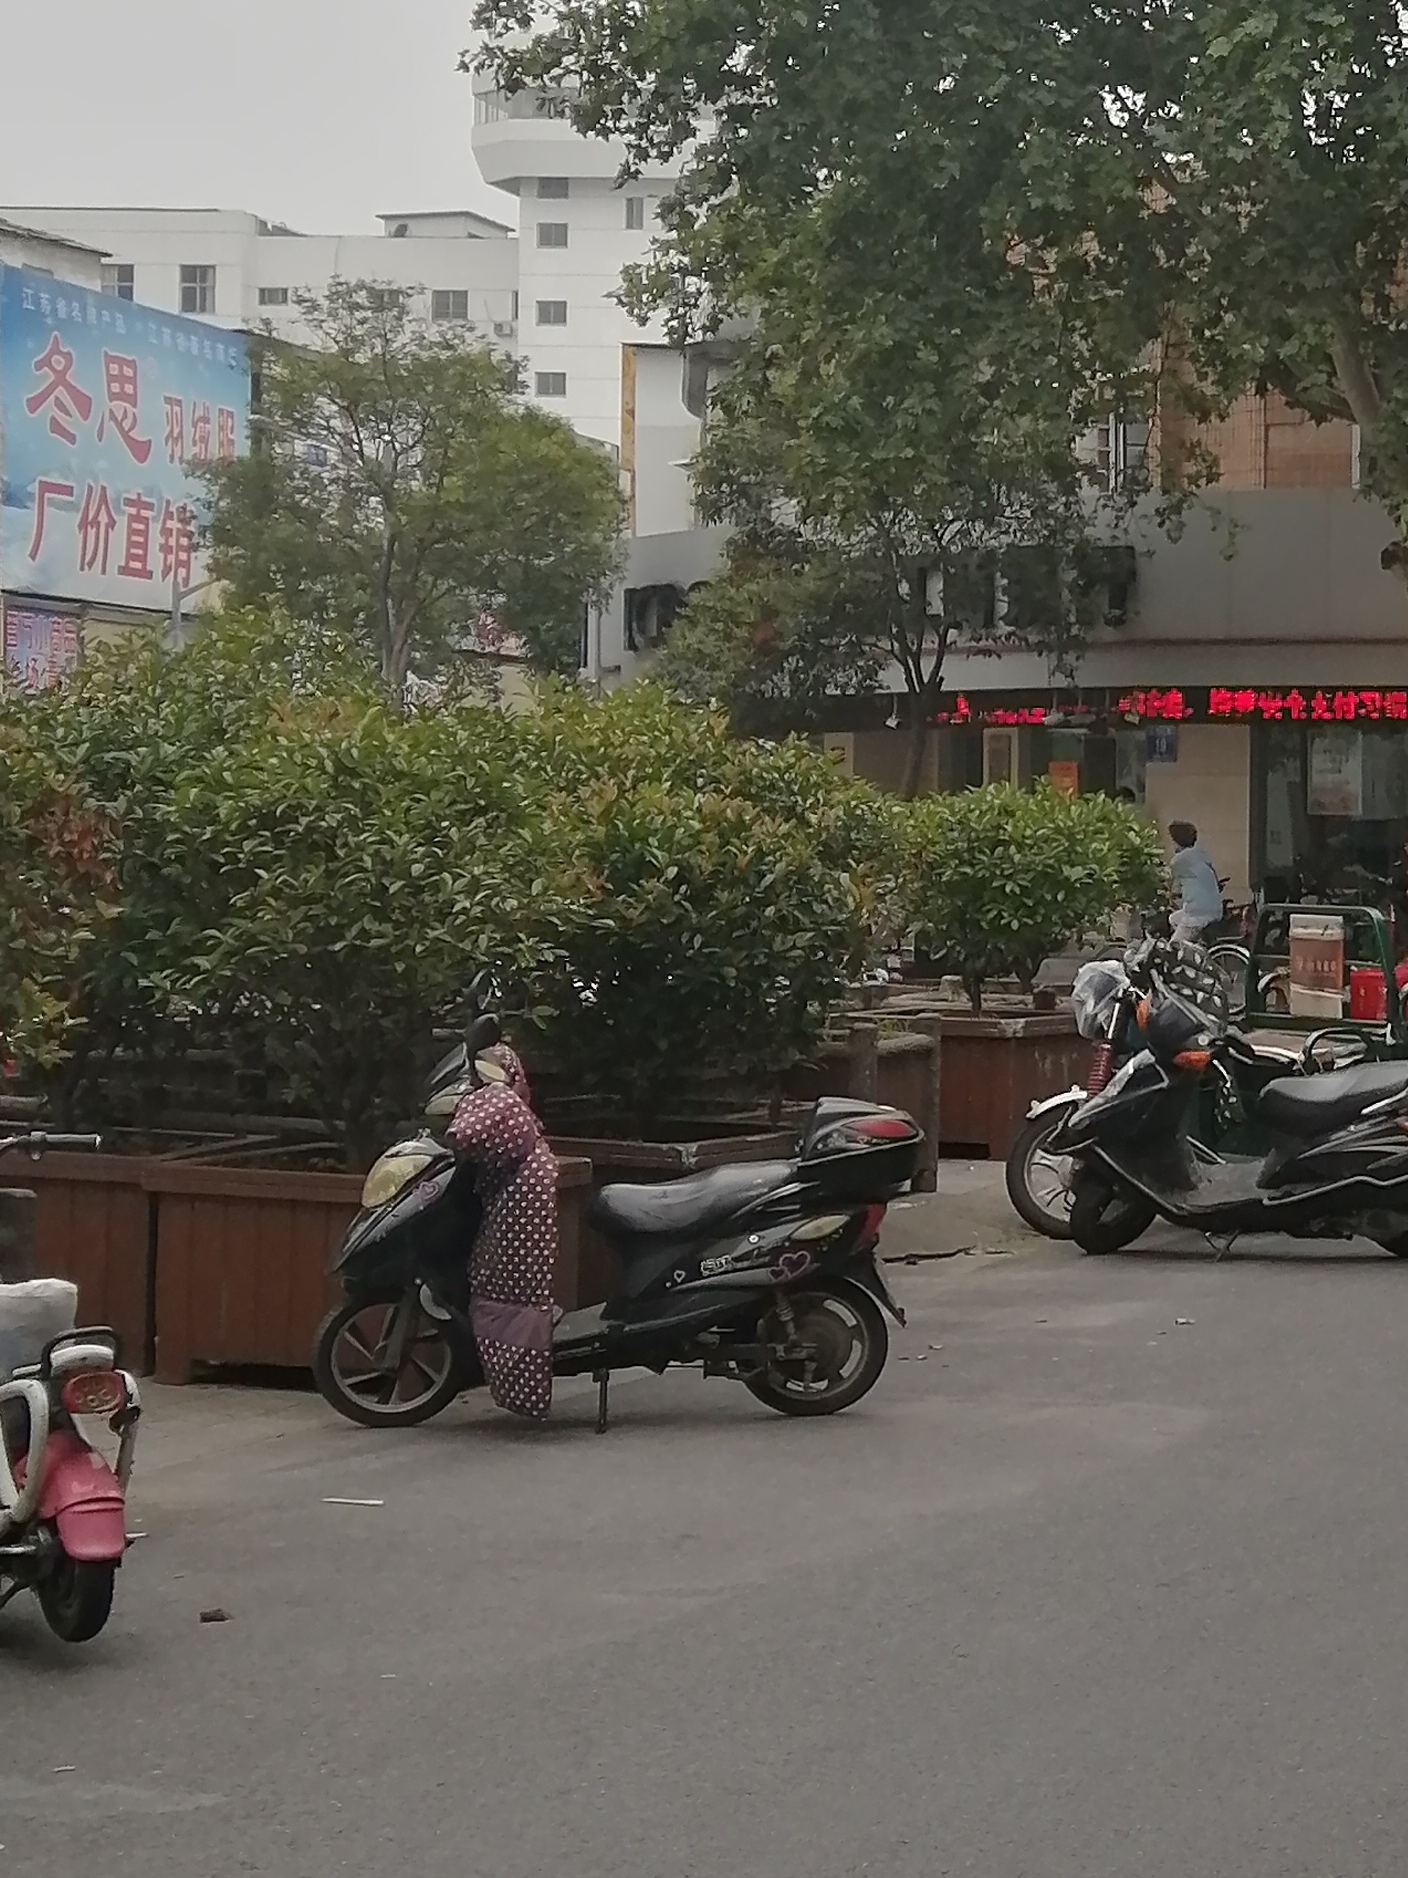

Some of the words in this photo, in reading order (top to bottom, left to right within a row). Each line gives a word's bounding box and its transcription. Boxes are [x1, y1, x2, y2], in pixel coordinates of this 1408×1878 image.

[25, 331, 152, 465] 冬思
[27, 476, 195, 589] 厂价直销
